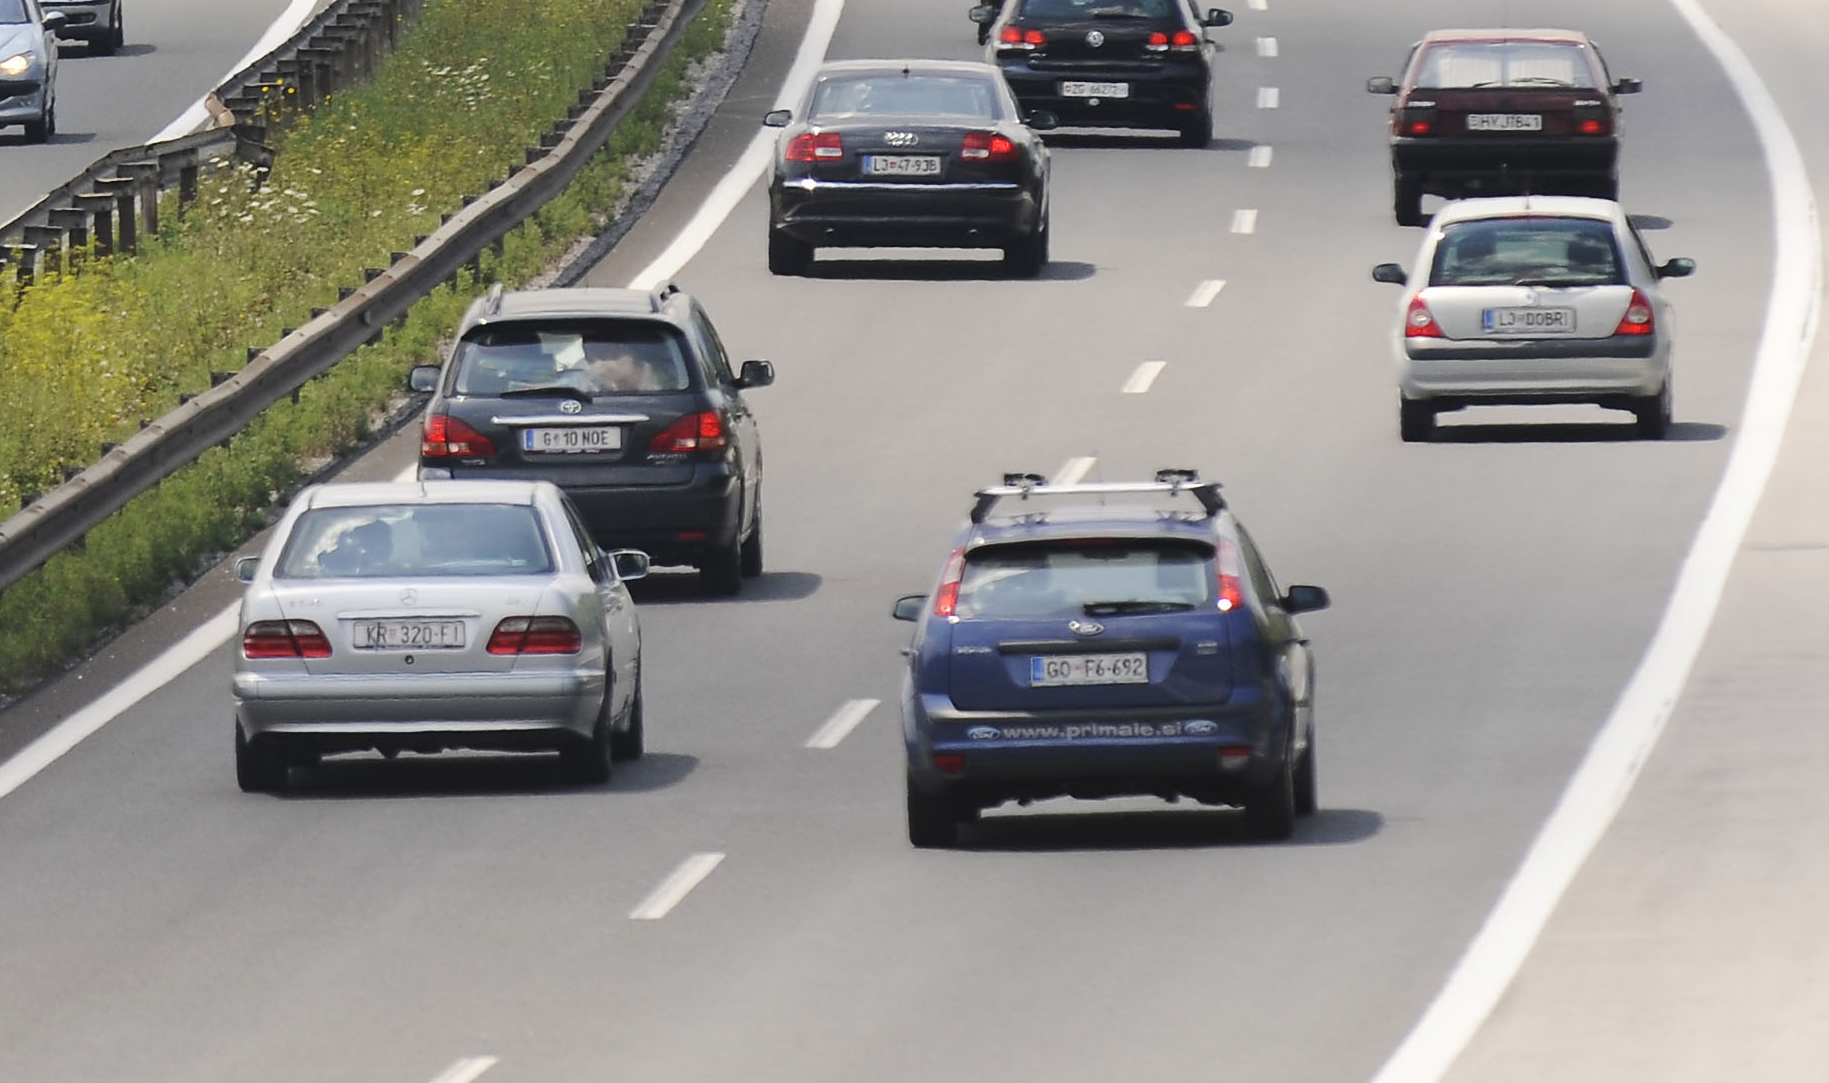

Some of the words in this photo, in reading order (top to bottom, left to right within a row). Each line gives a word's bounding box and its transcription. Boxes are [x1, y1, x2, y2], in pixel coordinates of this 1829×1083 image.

[874, 158, 889, 172] LJ
[1499, 311, 1516, 326] LJ
[1526, 310, 1569, 326] DOBRI
[365, 625, 387, 644] KR
[1046, 660, 1072, 679] GO
[1084, 657, 1144, 678] F6-692
